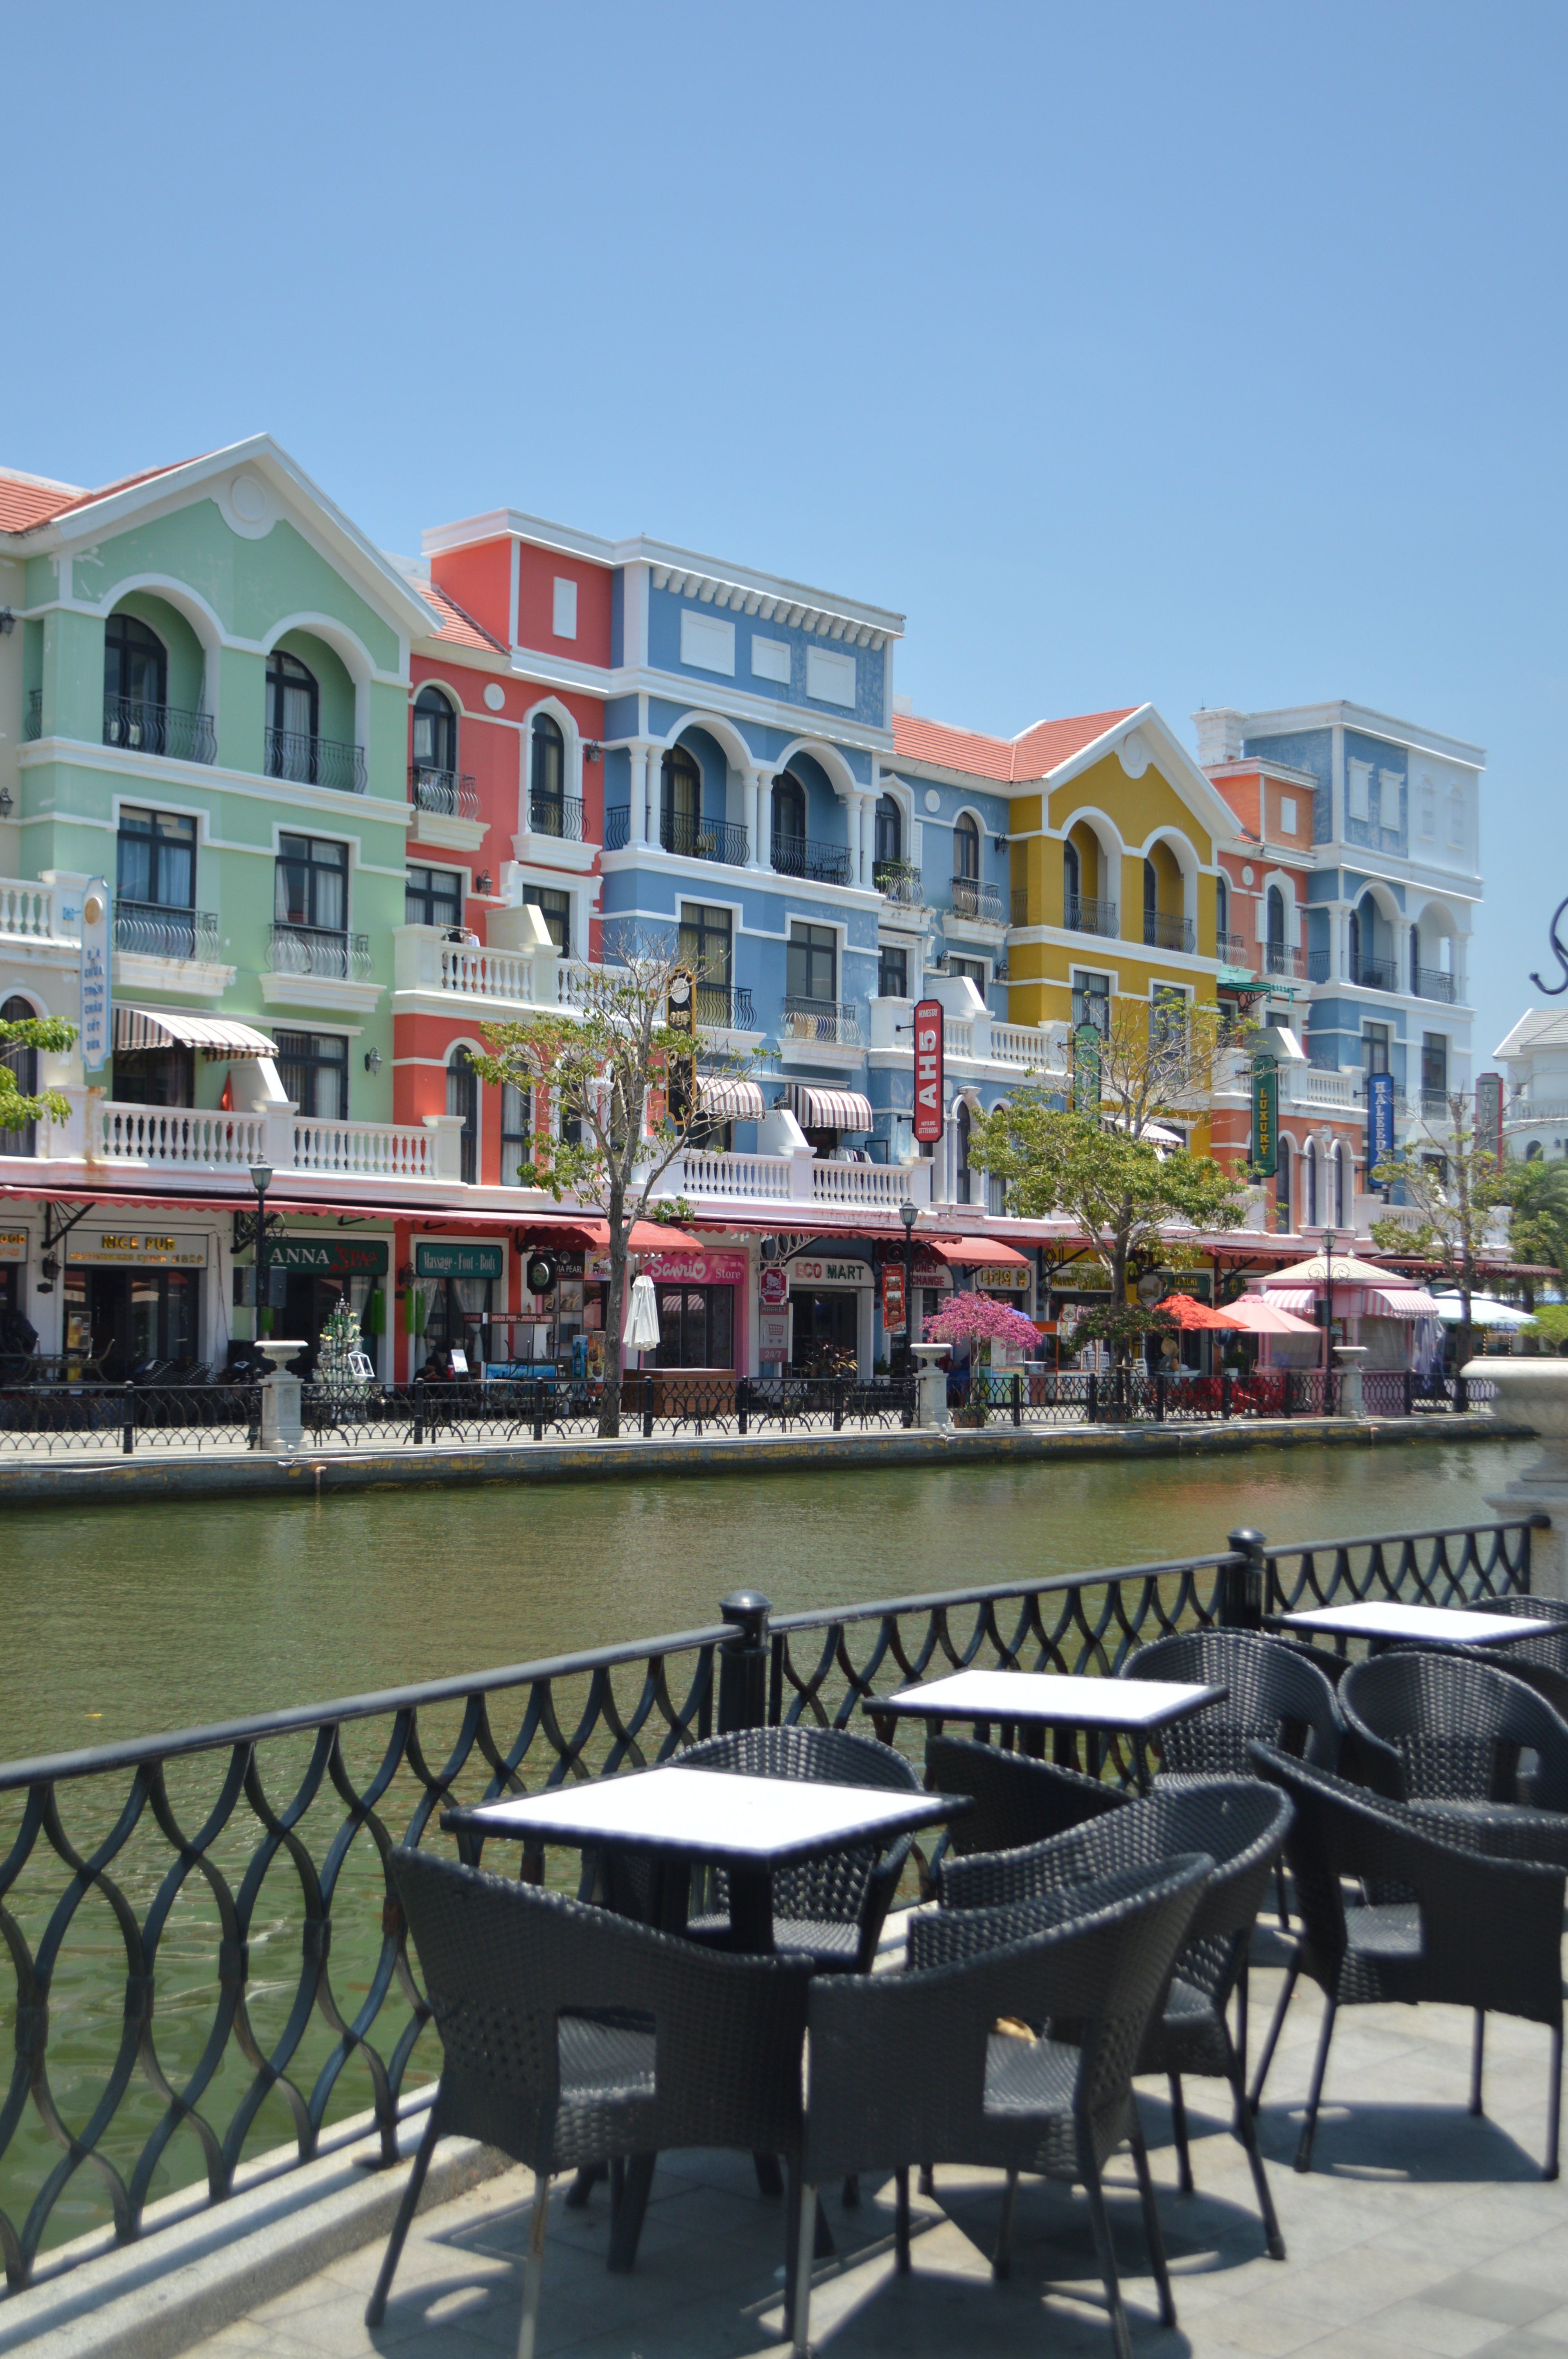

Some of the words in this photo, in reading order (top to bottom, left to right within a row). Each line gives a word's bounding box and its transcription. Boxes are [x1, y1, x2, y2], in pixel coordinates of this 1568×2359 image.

[87, 946, 101, 959] SA
[918, 1008, 938, 1018] HOMESTAY
[919, 1030, 936, 1108] AH5
[1259, 1088, 1269, 1154] LUXURY
[102, 1236, 139, 1249] NICE
[146, 1236, 176, 1250] PUB
[269, 1248, 330, 1264] ANNA
[330, 1245, 370, 1271] SPA
[424, 1252, 452, 1273] Massage
[458, 1253, 473, 1270] Foot
[480, 1254, 495, 1274] Body
[651, 1256, 706, 1280] Sanrio
[716, 1268, 741, 1279] Store
[796, 1263, 822, 1279] ECO
[827, 1264, 864, 1280] MART
[1174, 1277, 1198, 1286] LUXURY
